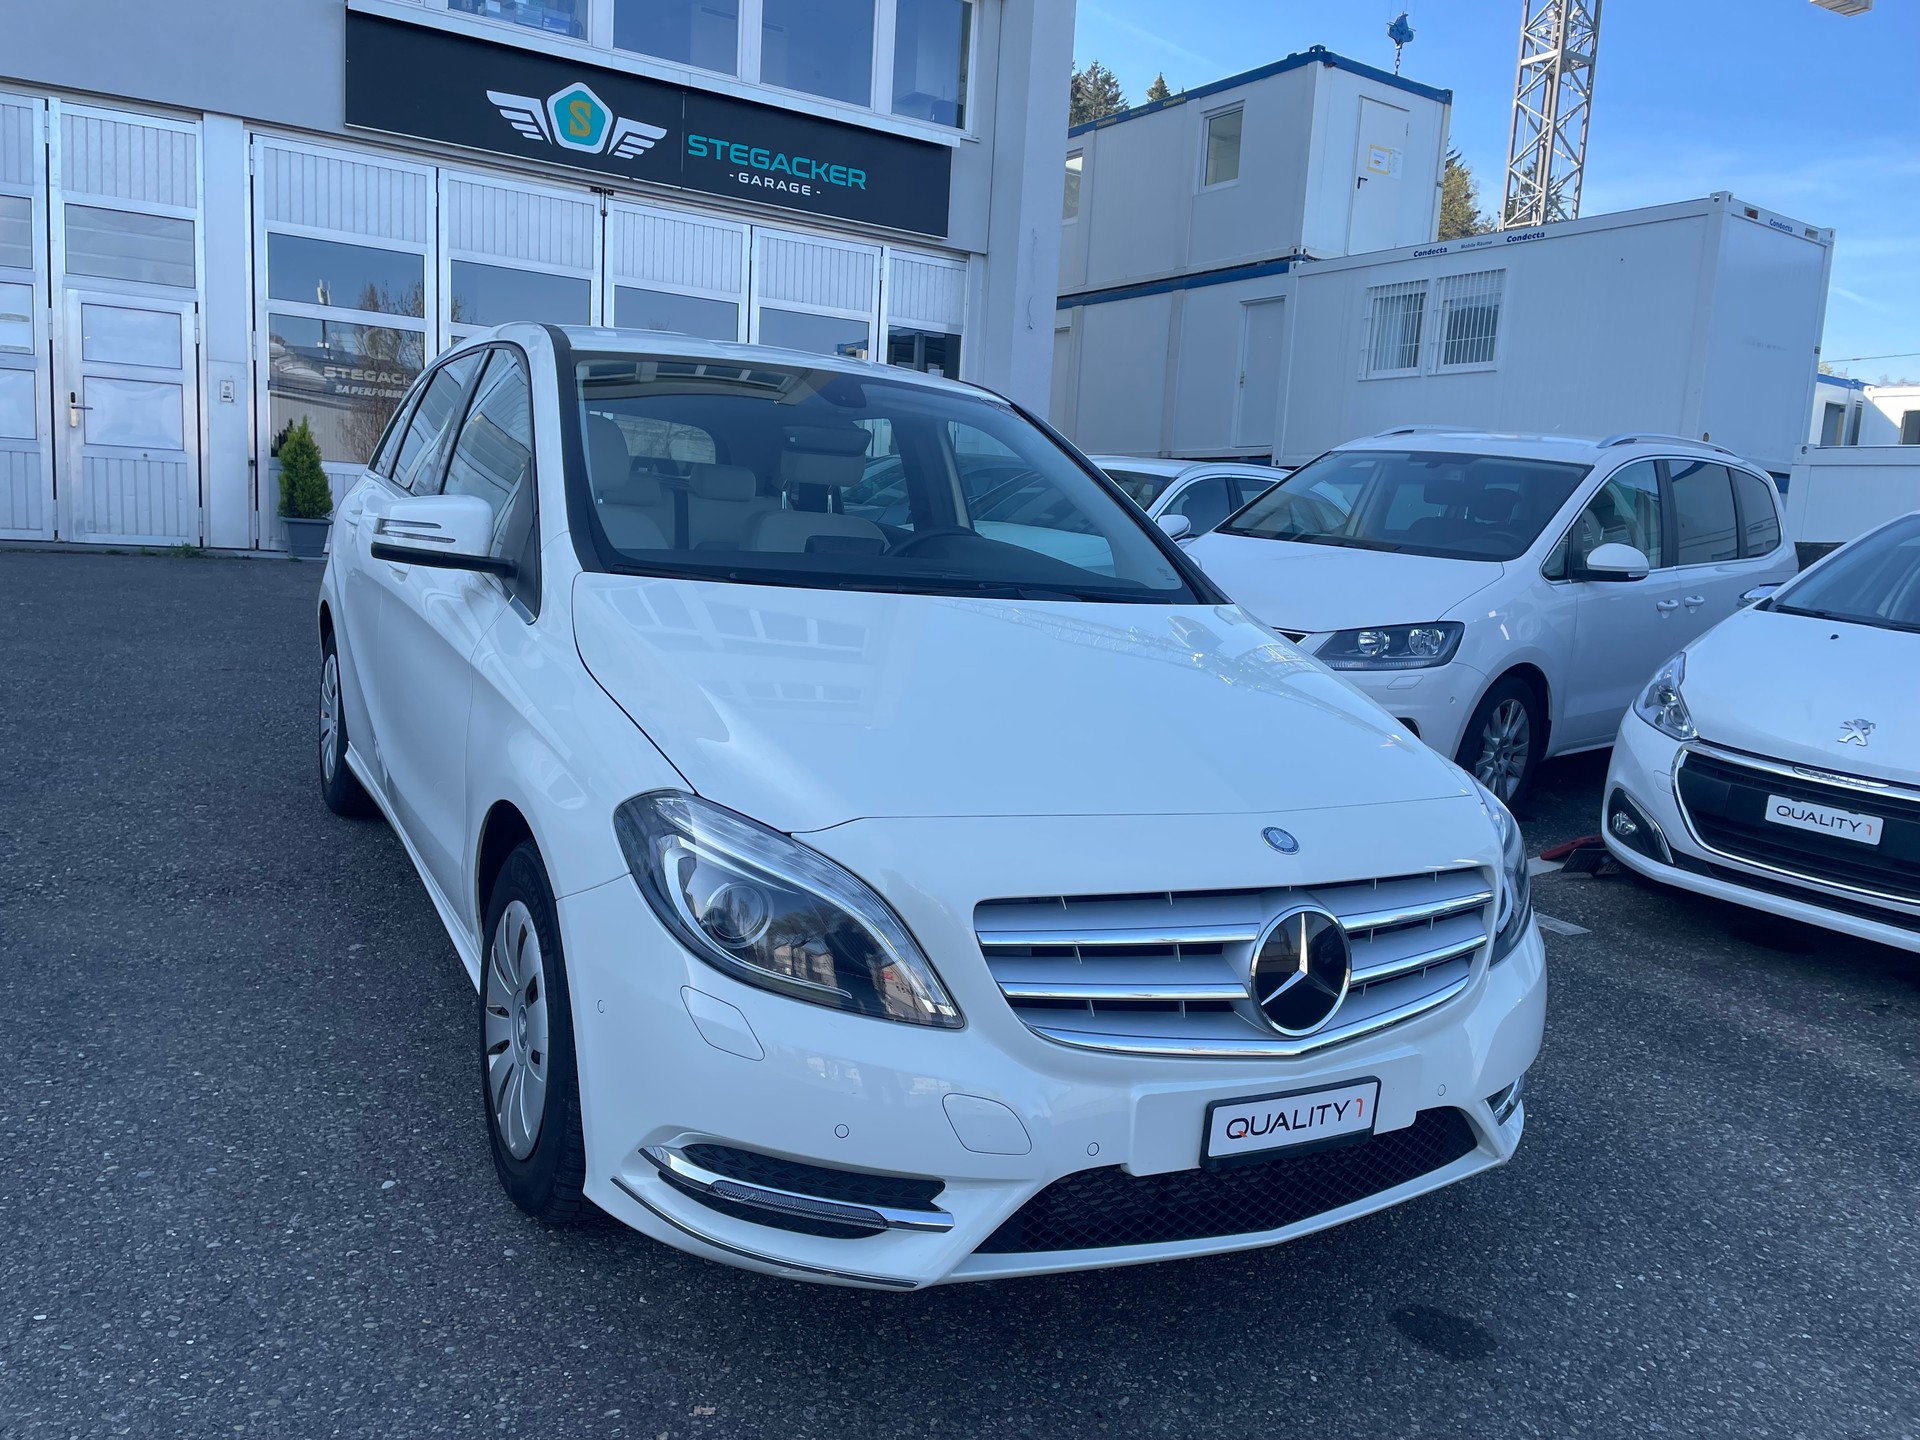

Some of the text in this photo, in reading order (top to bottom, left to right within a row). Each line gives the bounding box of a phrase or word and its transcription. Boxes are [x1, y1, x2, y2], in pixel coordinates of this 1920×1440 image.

[688, 134, 866, 190] STEGACKER
[1769, 218, 1793, 233] Condecta
[1507, 231, 1545, 242] Condecta
[1413, 247, 1448, 258] Condecta
